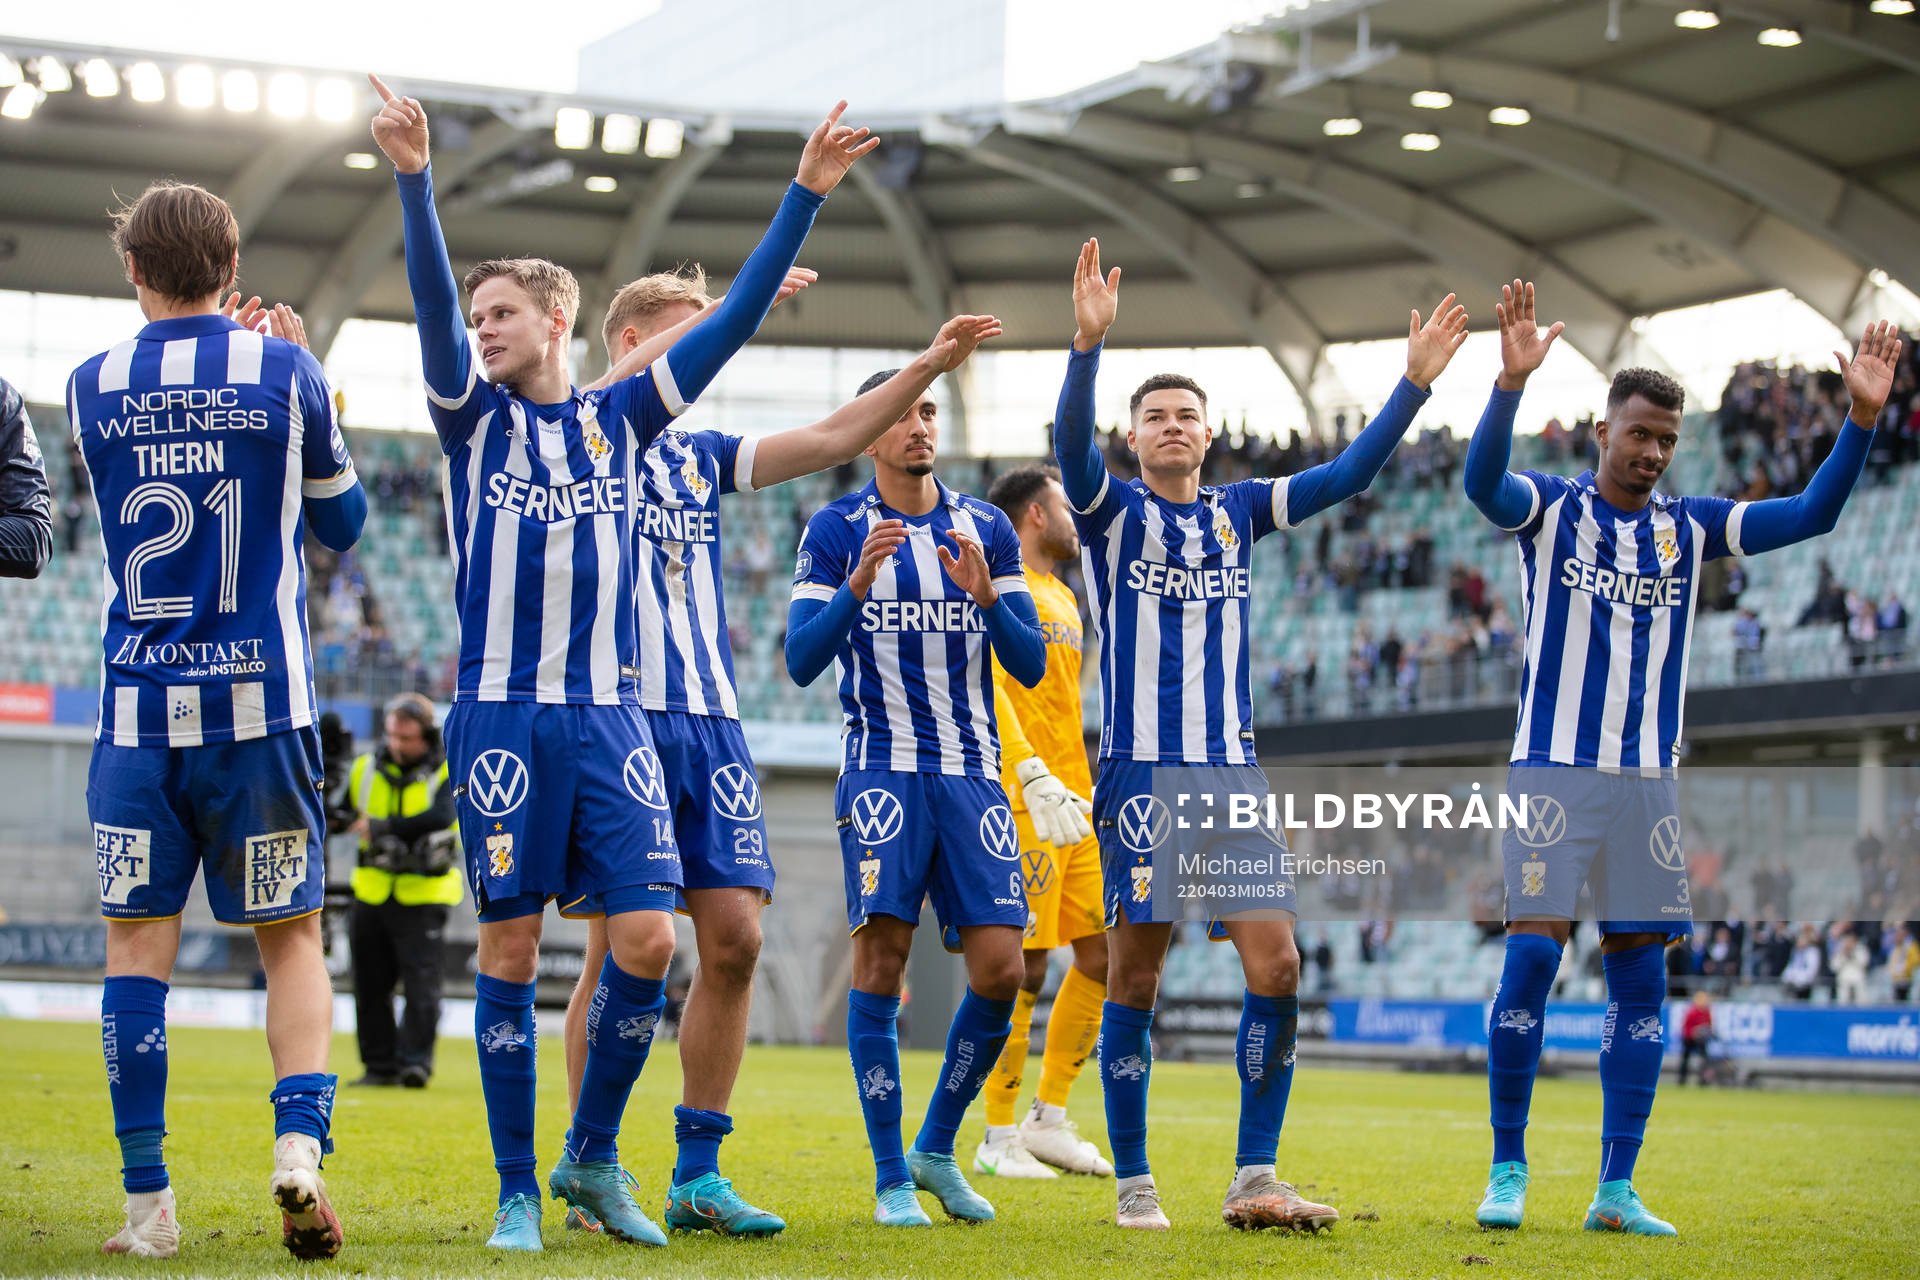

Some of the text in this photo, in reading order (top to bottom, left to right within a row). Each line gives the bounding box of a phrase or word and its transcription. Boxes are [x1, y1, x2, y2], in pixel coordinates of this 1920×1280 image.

[123, 387, 238, 414] NORDIC
[98, 410, 269, 439] WELLNESS
[132, 440, 224, 478] THERN
[485, 472, 625, 521] SERNEKE
[120, 478, 242, 621] 21
[1126, 560, 1248, 600] SERNEKE
[1561, 557, 1682, 606] SERNEKE
[210, 661, 266, 676] INSTALCO
[652, 817, 674, 848] 14
[733, 827, 763, 855] 29
[252, 835, 297, 862] EFF
[647, 852, 677, 860] CRAFT
[735, 857, 763, 866] CRAFT
[252, 856, 302, 883] EKT
[252, 882, 280, 905] IV
[1009, 871, 1021, 897] 6
[1677, 878, 1690, 904] 3
[994, 898, 1020, 906] CRAFT
[1661, 906, 1689, 914] CRAFT
[102, 1013, 121, 1085] LFVERLOK
[1246, 1022, 1267, 1083] SILFVERLOK
